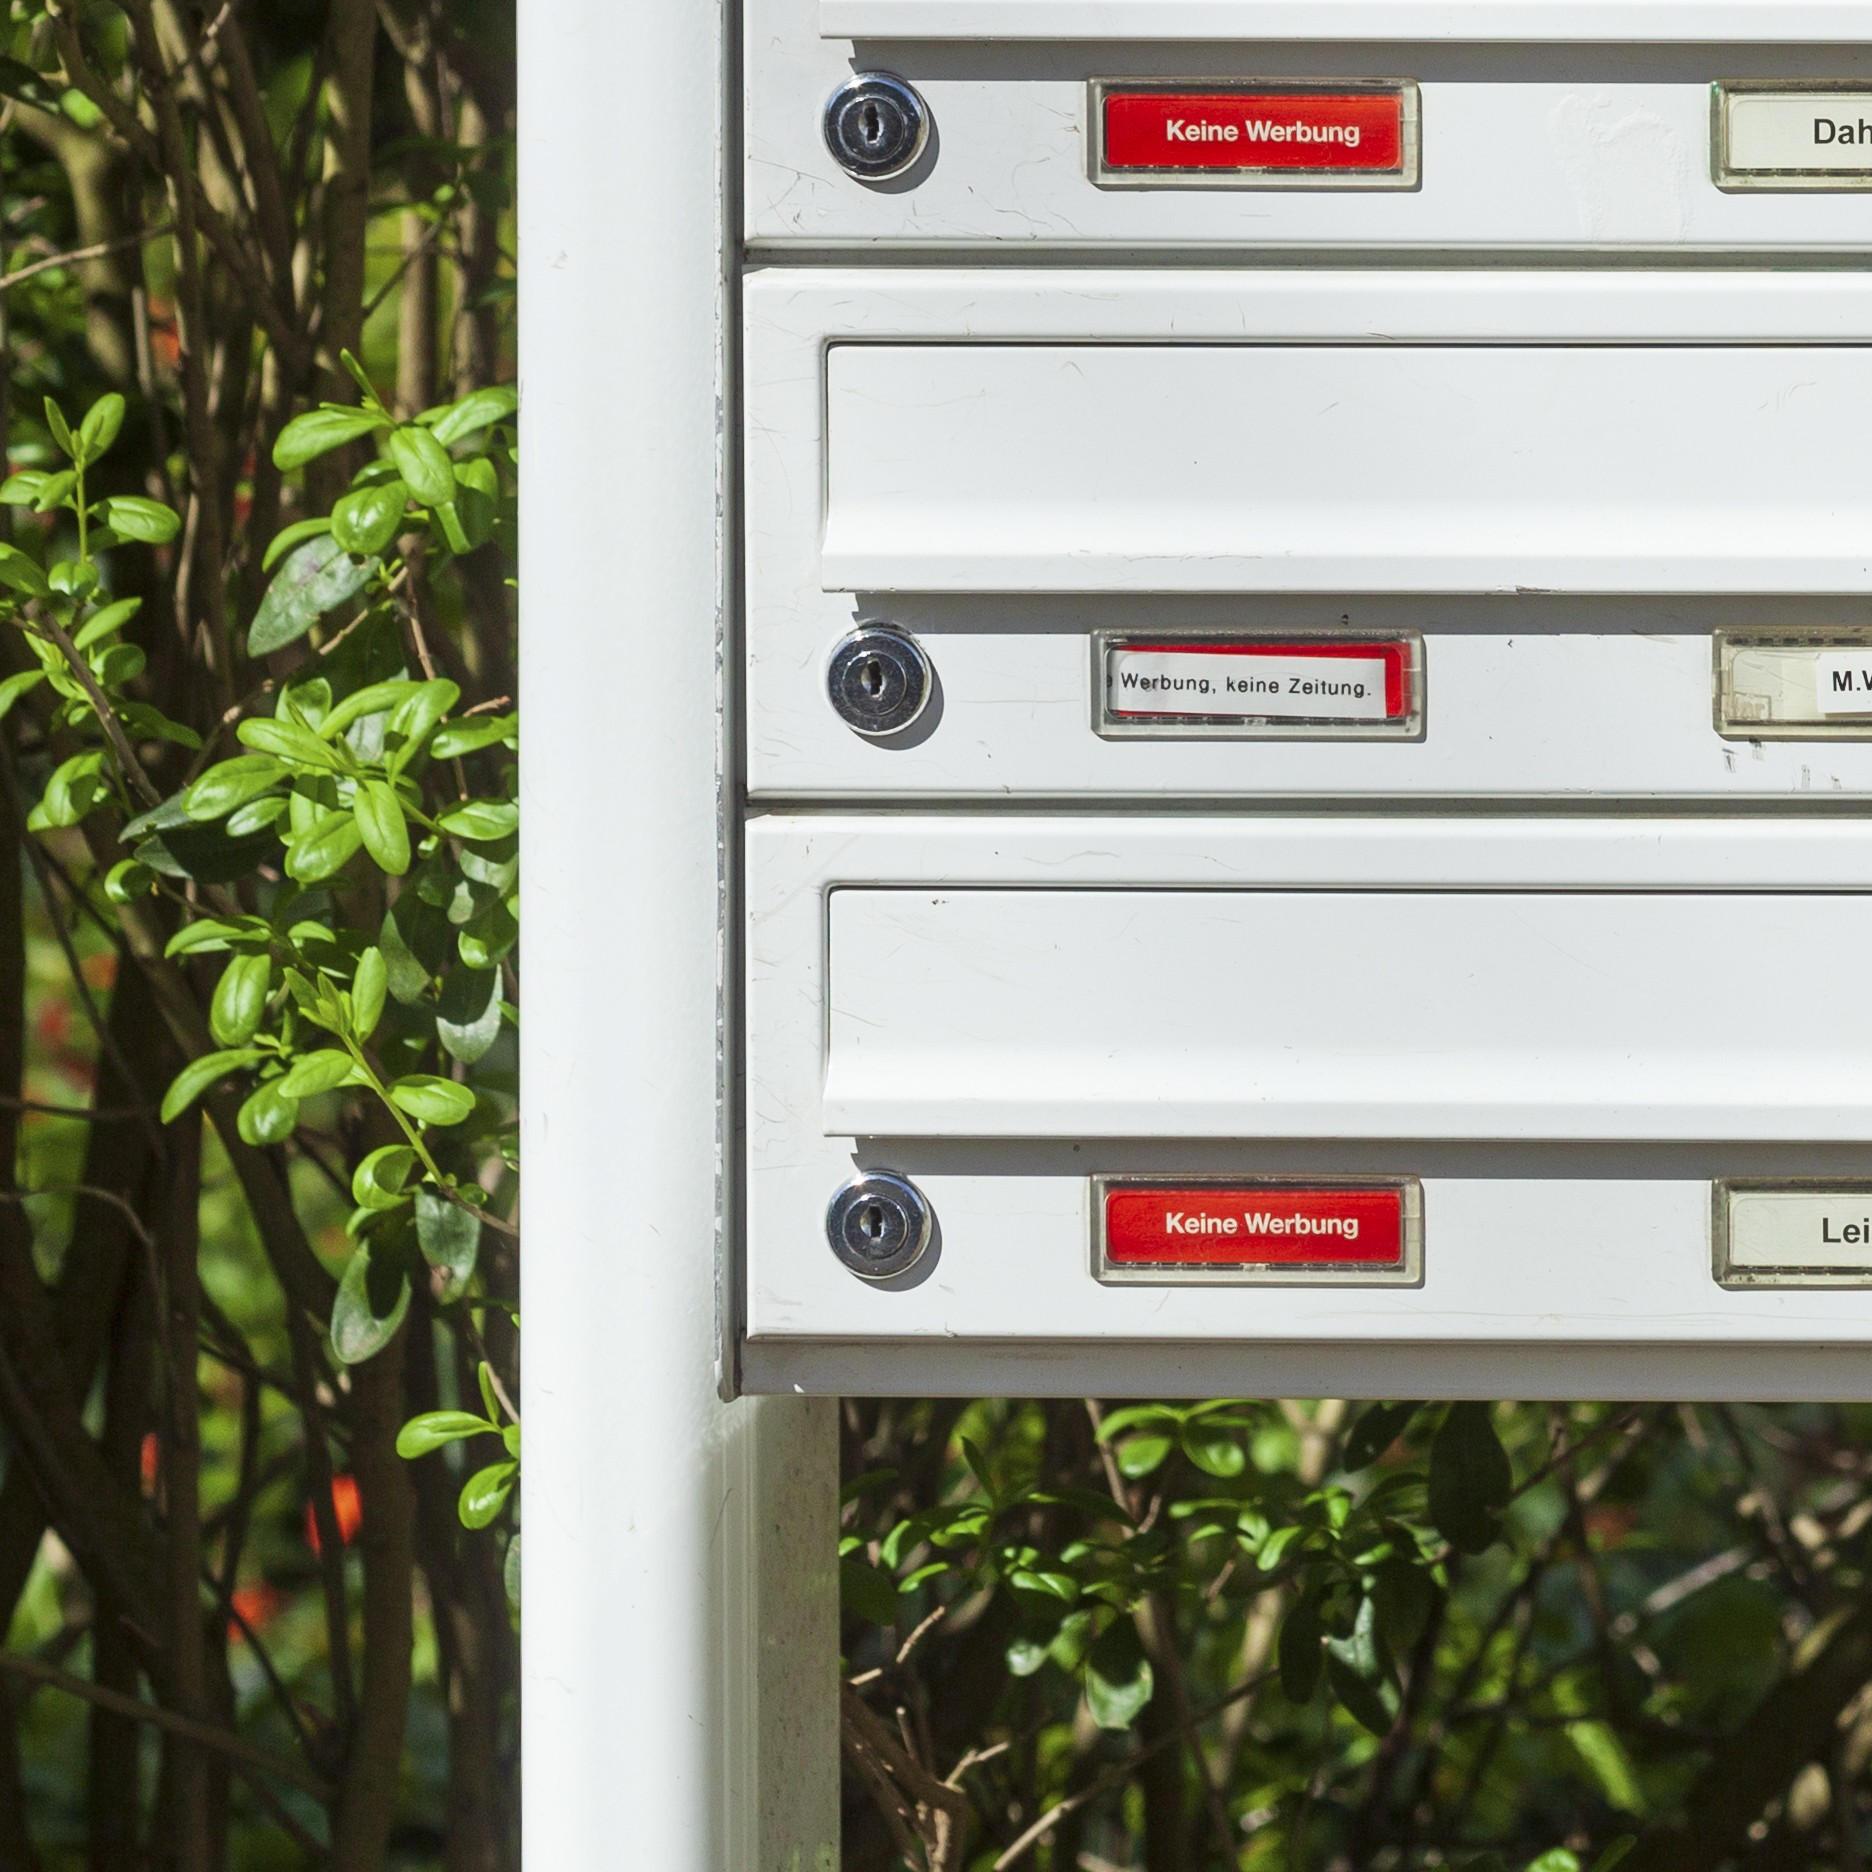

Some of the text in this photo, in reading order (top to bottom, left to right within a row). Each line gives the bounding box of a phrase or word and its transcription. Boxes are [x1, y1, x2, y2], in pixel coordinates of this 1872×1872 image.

[1168, 120, 1360, 147] Keine Werbung
[1121, 672, 1216, 694] Werbung,
[1226, 677, 1279, 693] keine
[1289, 678, 1372, 699] Zeitung.
[1167, 1212, 1358, 1240] Keine Werbung
